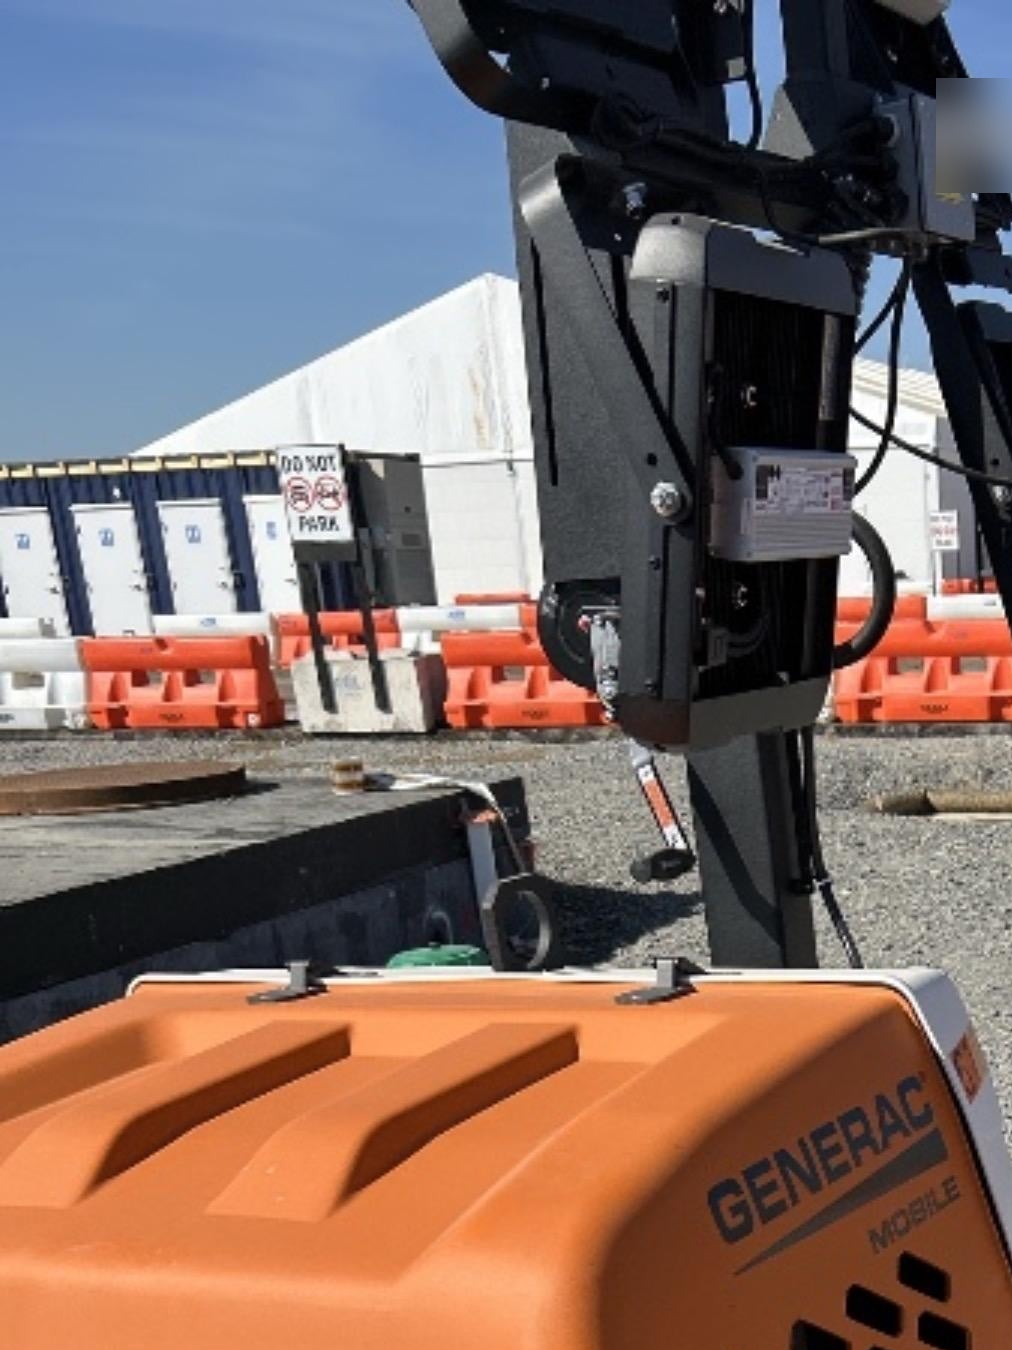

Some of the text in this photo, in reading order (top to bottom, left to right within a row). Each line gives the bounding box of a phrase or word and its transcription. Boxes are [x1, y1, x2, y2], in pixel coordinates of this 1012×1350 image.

[281, 455, 336, 473] DO NOT
[299, 515, 340, 532] PARK
[707, 1075, 933, 1244] GENERAC
[868, 1175, 960, 1254] MOBILE
